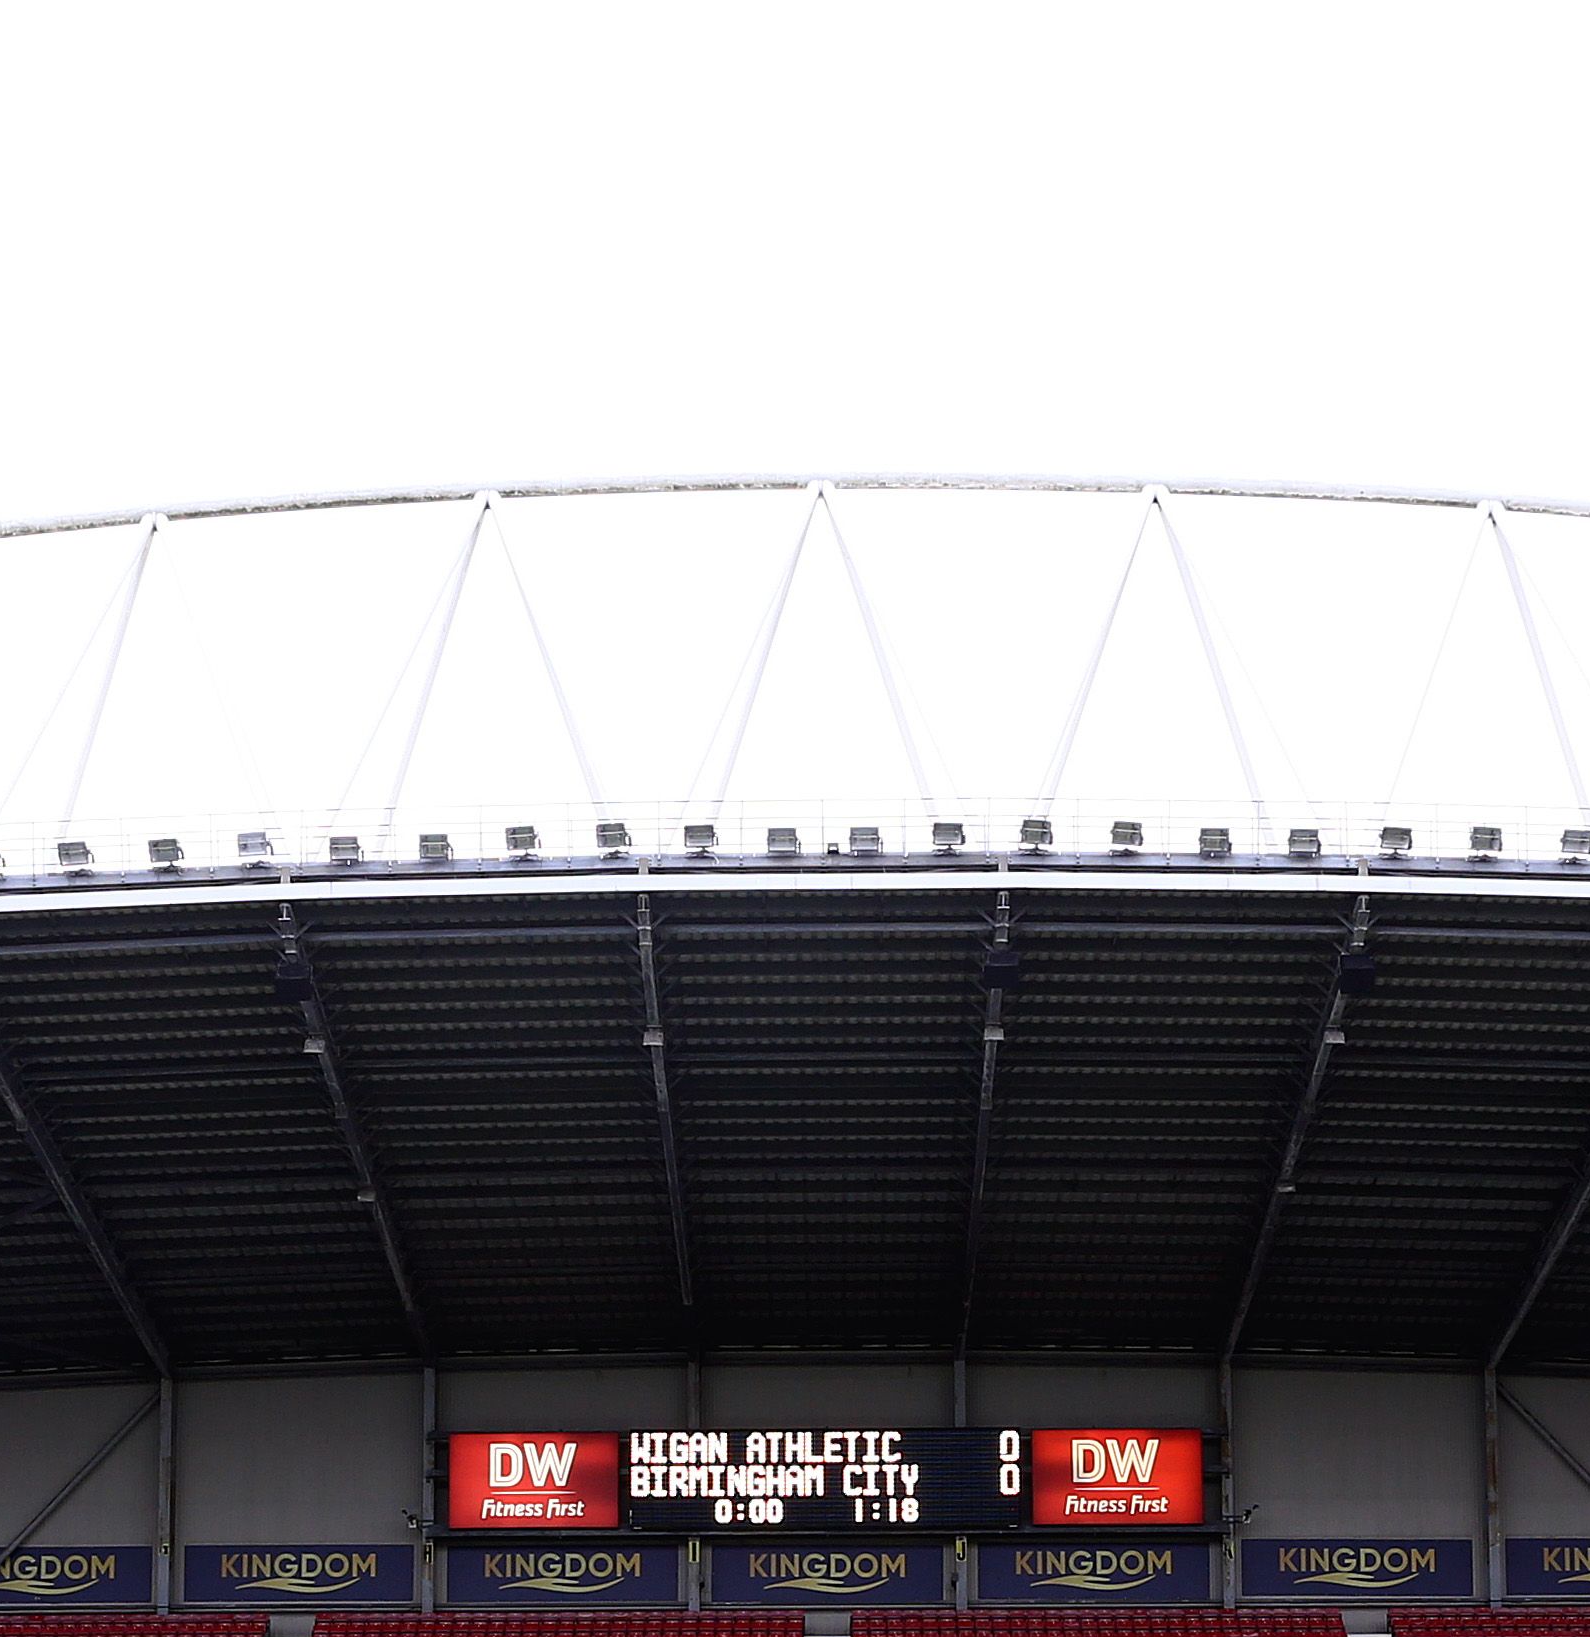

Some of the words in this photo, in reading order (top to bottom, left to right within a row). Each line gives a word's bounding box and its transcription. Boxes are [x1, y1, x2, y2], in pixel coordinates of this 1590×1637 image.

[630, 1432, 728, 1463] WIGAN
[746, 1431, 902, 1463] ATHLETIC
[999, 1430, 1020, 1462] 0
[488, 1442, 577, 1488] DW
[1071, 1438, 1159, 1484] DW
[630, 1465, 824, 1497] BIRMINGHAM
[843, 1464, 919, 1496] CITY
[999, 1463, 1020, 1495] 0
[480, 1499, 543, 1520] Fitness
[547, 1499, 585, 1520] First
[714, 1498, 784, 1525] 0:00
[855, 1498, 919, 1523] 1:18
[1065, 1495, 1127, 1515] Fitness
[1130, 1495, 1169, 1515] First
[221, 1553, 377, 1578] KINGDOM
[485, 1553, 641, 1578] KINGDOM
[750, 1553, 906, 1578] KINGDOM
[1016, 1551, 1173, 1575] KINGDOM
[1279, 1548, 1436, 1572] KINGDOM
